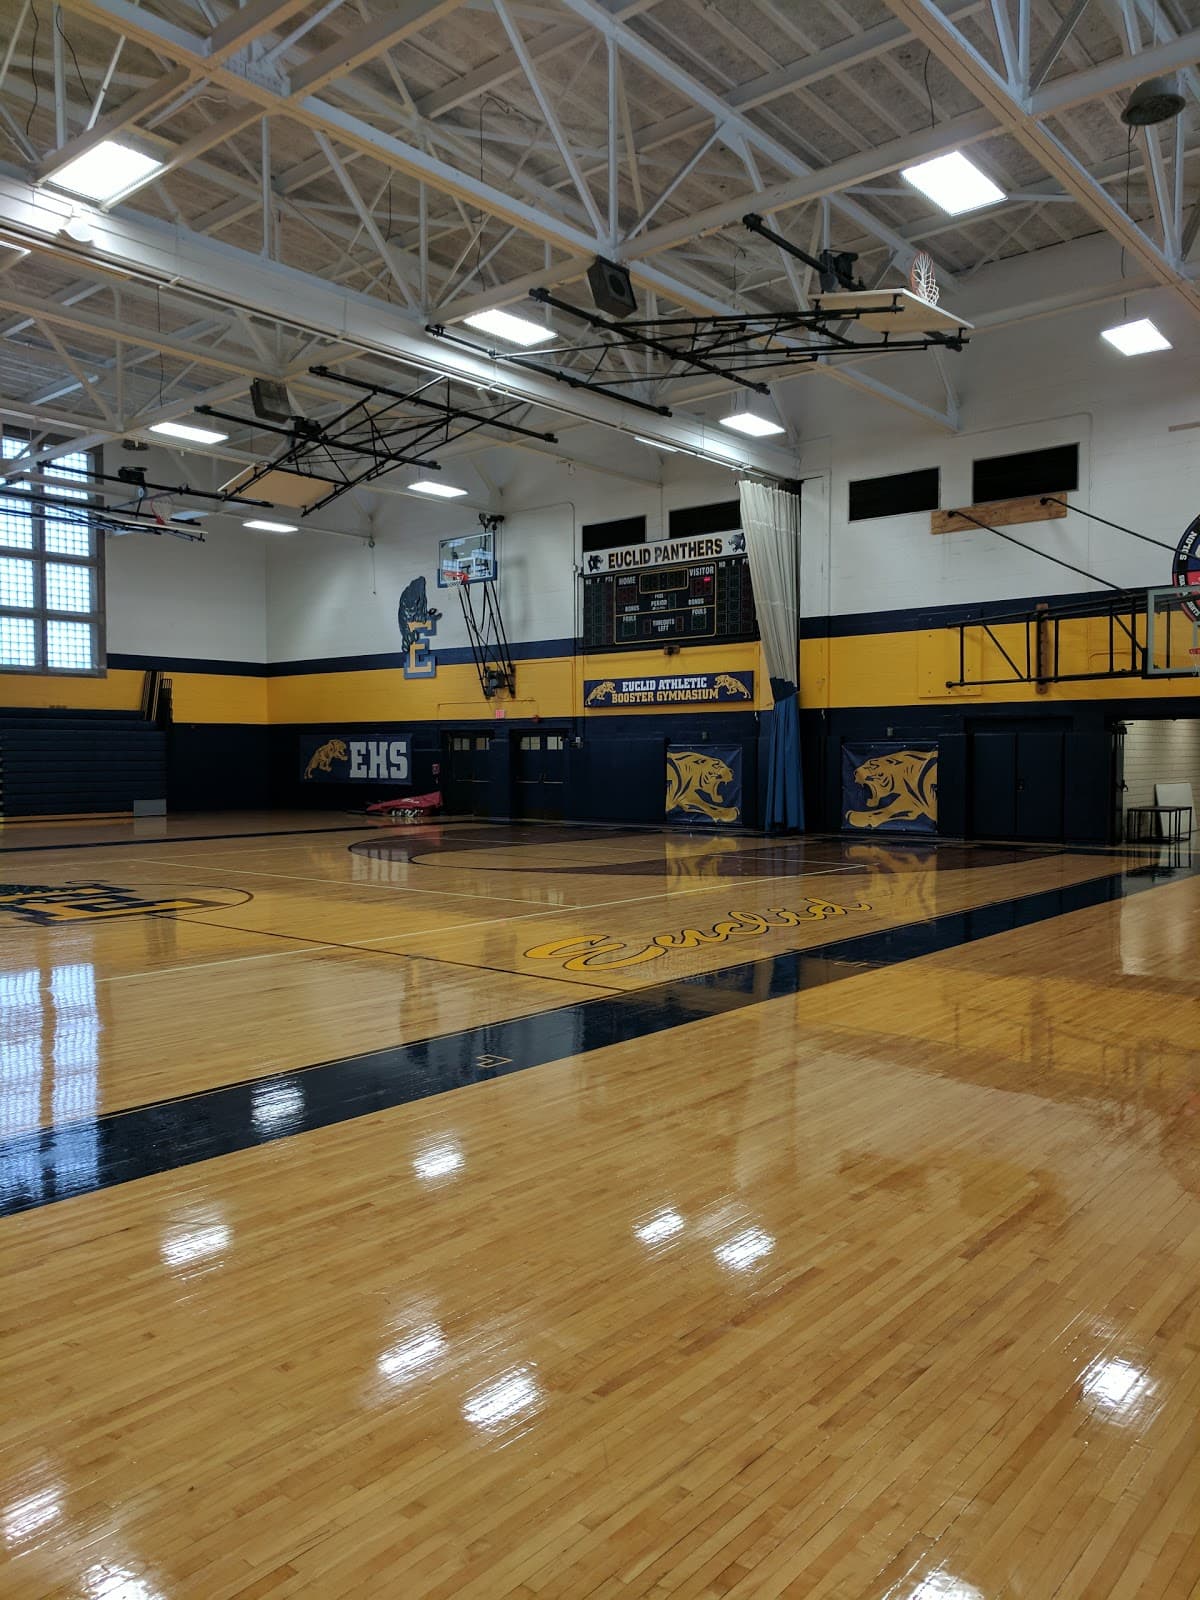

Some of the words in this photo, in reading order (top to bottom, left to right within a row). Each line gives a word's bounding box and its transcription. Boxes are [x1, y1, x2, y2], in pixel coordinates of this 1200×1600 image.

[608, 548, 651, 569] EUCLID
[654, 538, 723, 563] PANTHERS
[689, 566, 714, 577] VISITOR
[618, 576, 636, 585] HOME
[624, 604, 640, 612] BONUS
[651, 599, 668, 607] PERIOD
[688, 597, 705, 606] BONUS
[622, 679, 656, 692] EUCLID
[658, 677, 708, 690] ATHLETIC
[611, 691, 655, 704] BOOSTER
[657, 688, 719, 701] GYMNASIUM
[348, 741, 409, 779] EHS
[523, 897, 872, 971] Euclid
